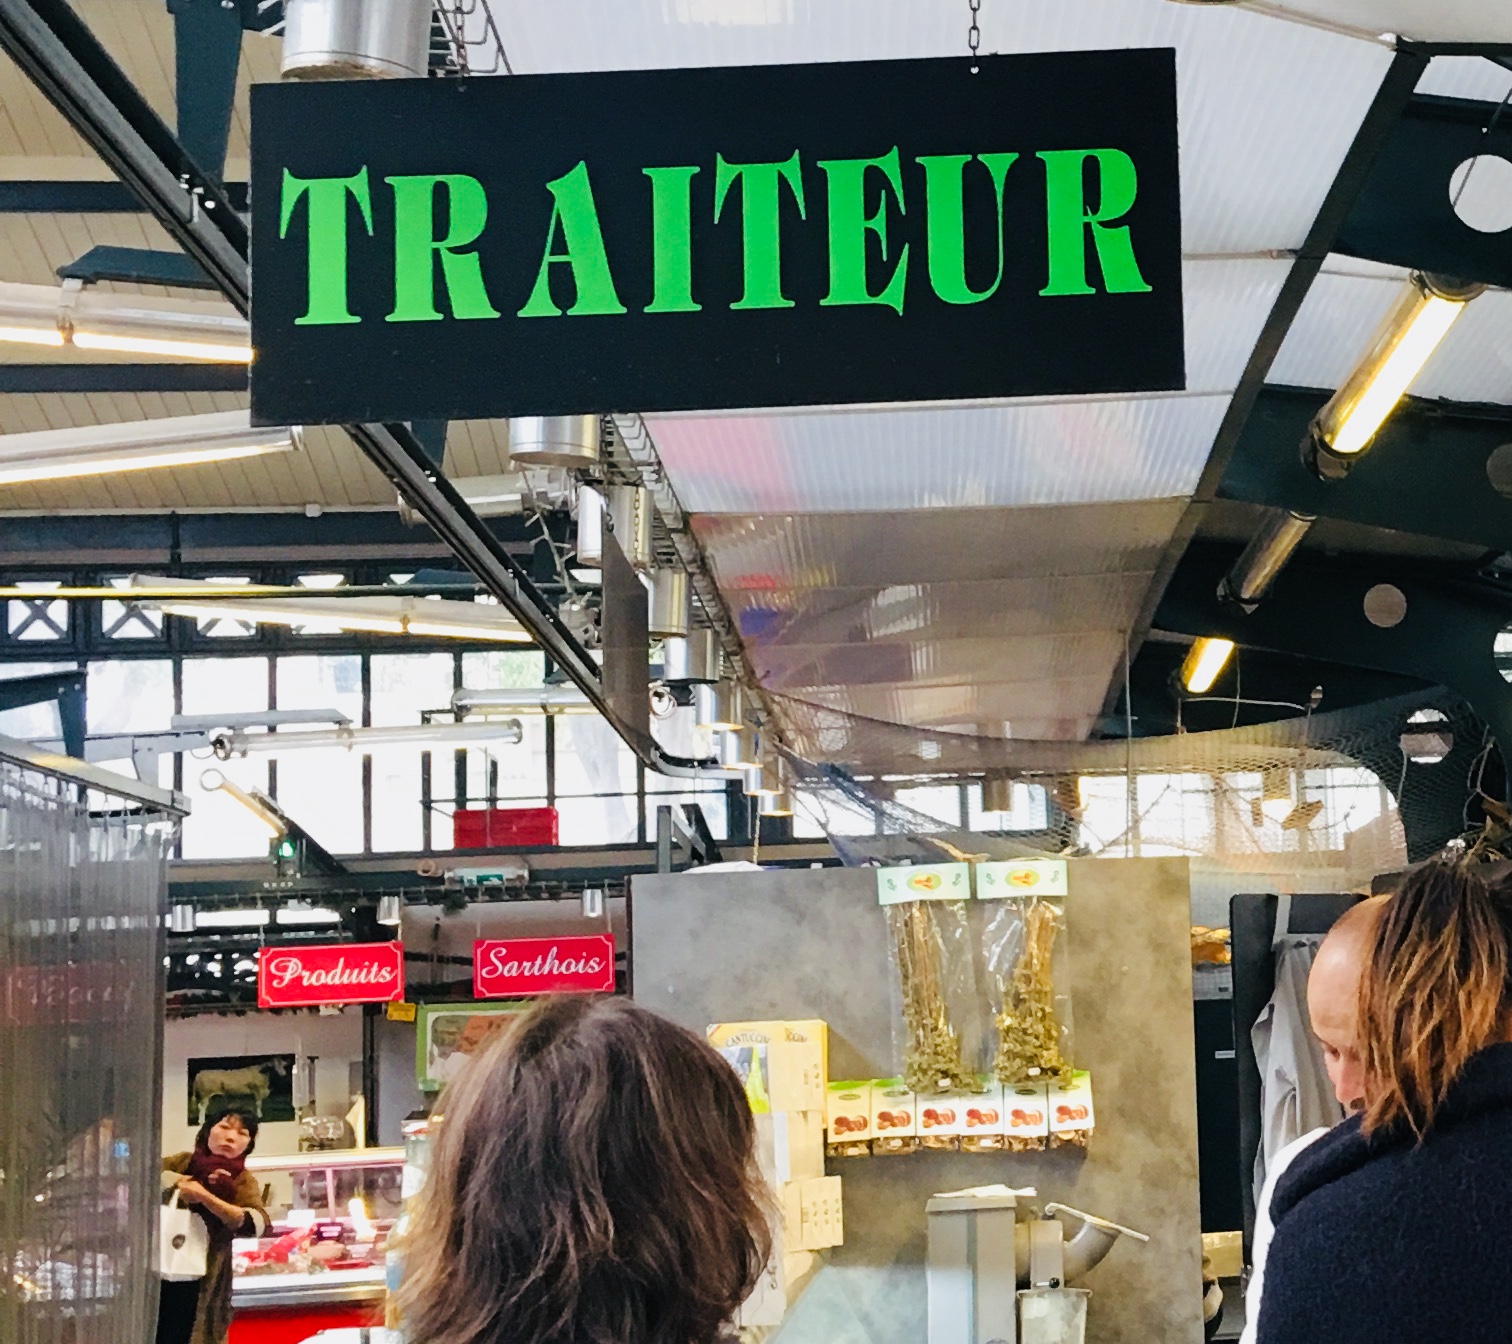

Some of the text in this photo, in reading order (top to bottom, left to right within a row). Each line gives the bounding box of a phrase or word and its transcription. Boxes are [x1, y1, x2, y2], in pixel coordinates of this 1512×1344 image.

[279, 145, 1152, 325] TRAITEUR
[270, 957, 397, 989] Produits
[481, 946, 606, 979] Sarthois
